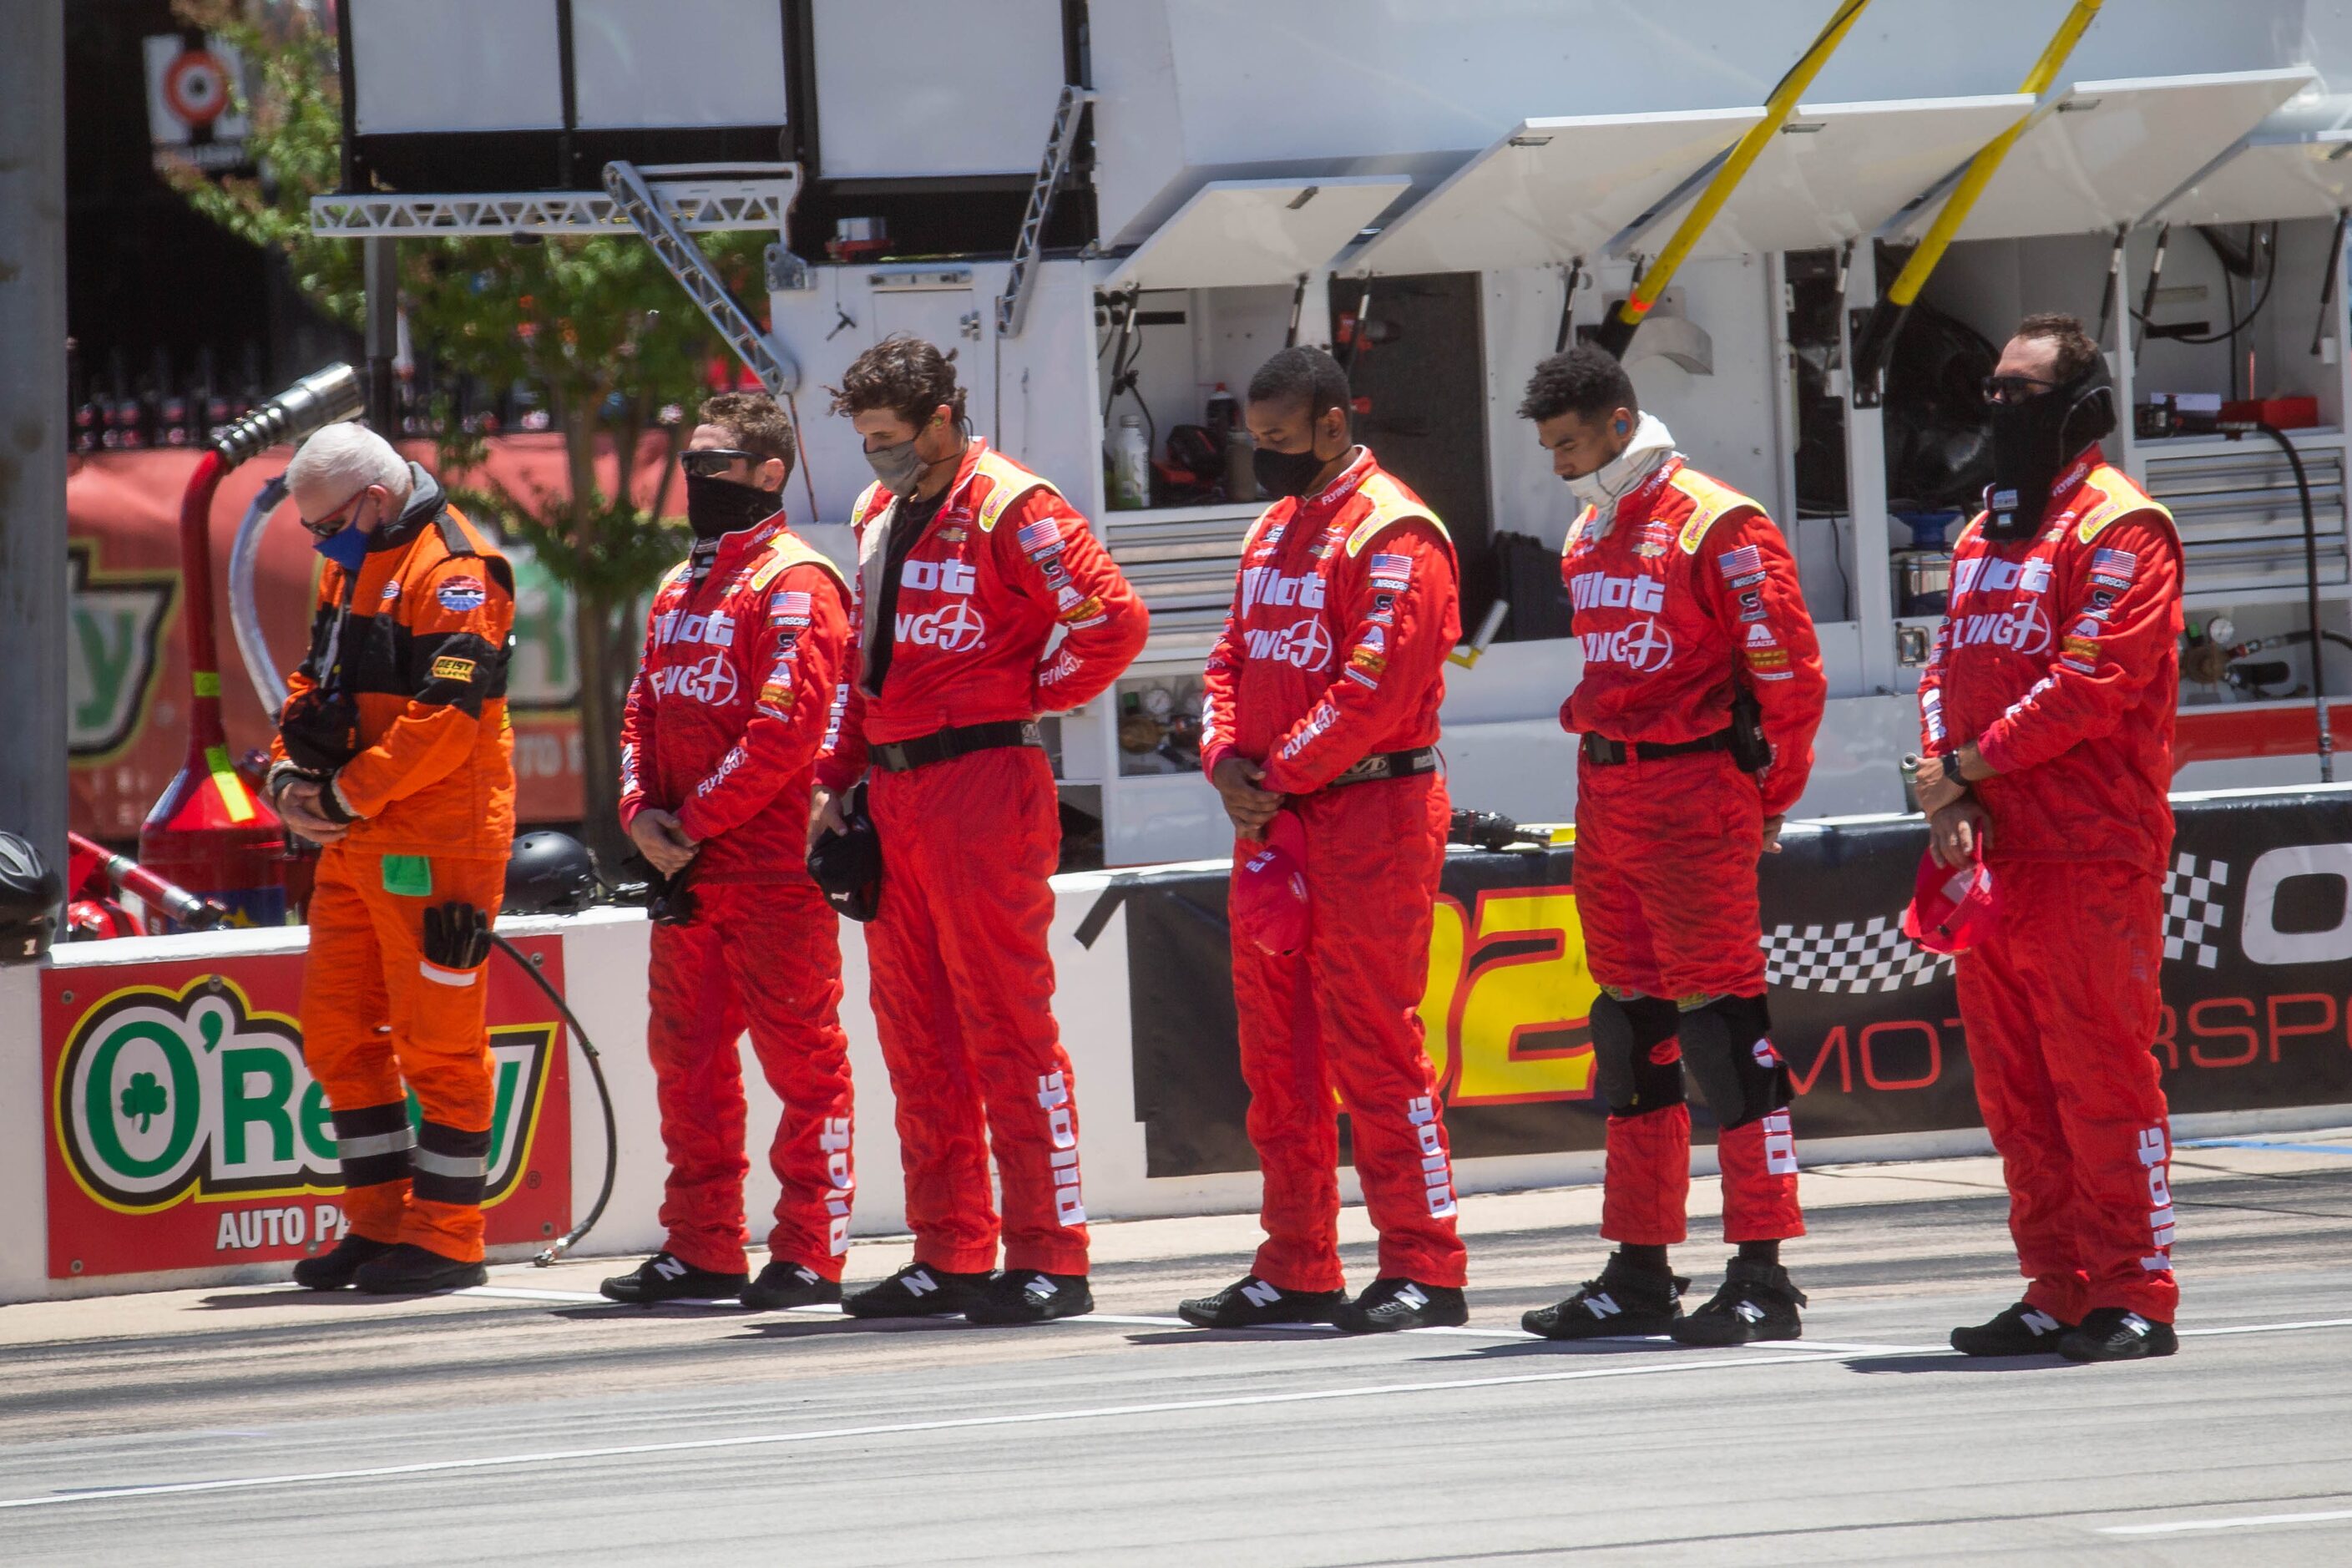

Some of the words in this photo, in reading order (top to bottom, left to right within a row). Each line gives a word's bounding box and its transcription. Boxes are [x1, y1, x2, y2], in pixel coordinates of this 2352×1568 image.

[2097, 574, 2131, 590] NASCAR
[777, 616, 811, 626] NASCAR
[23, 938, 37, 956] 1
[86, 1009, 520, 1179] O'Re
[216, 1206, 305, 1250] AUTO
